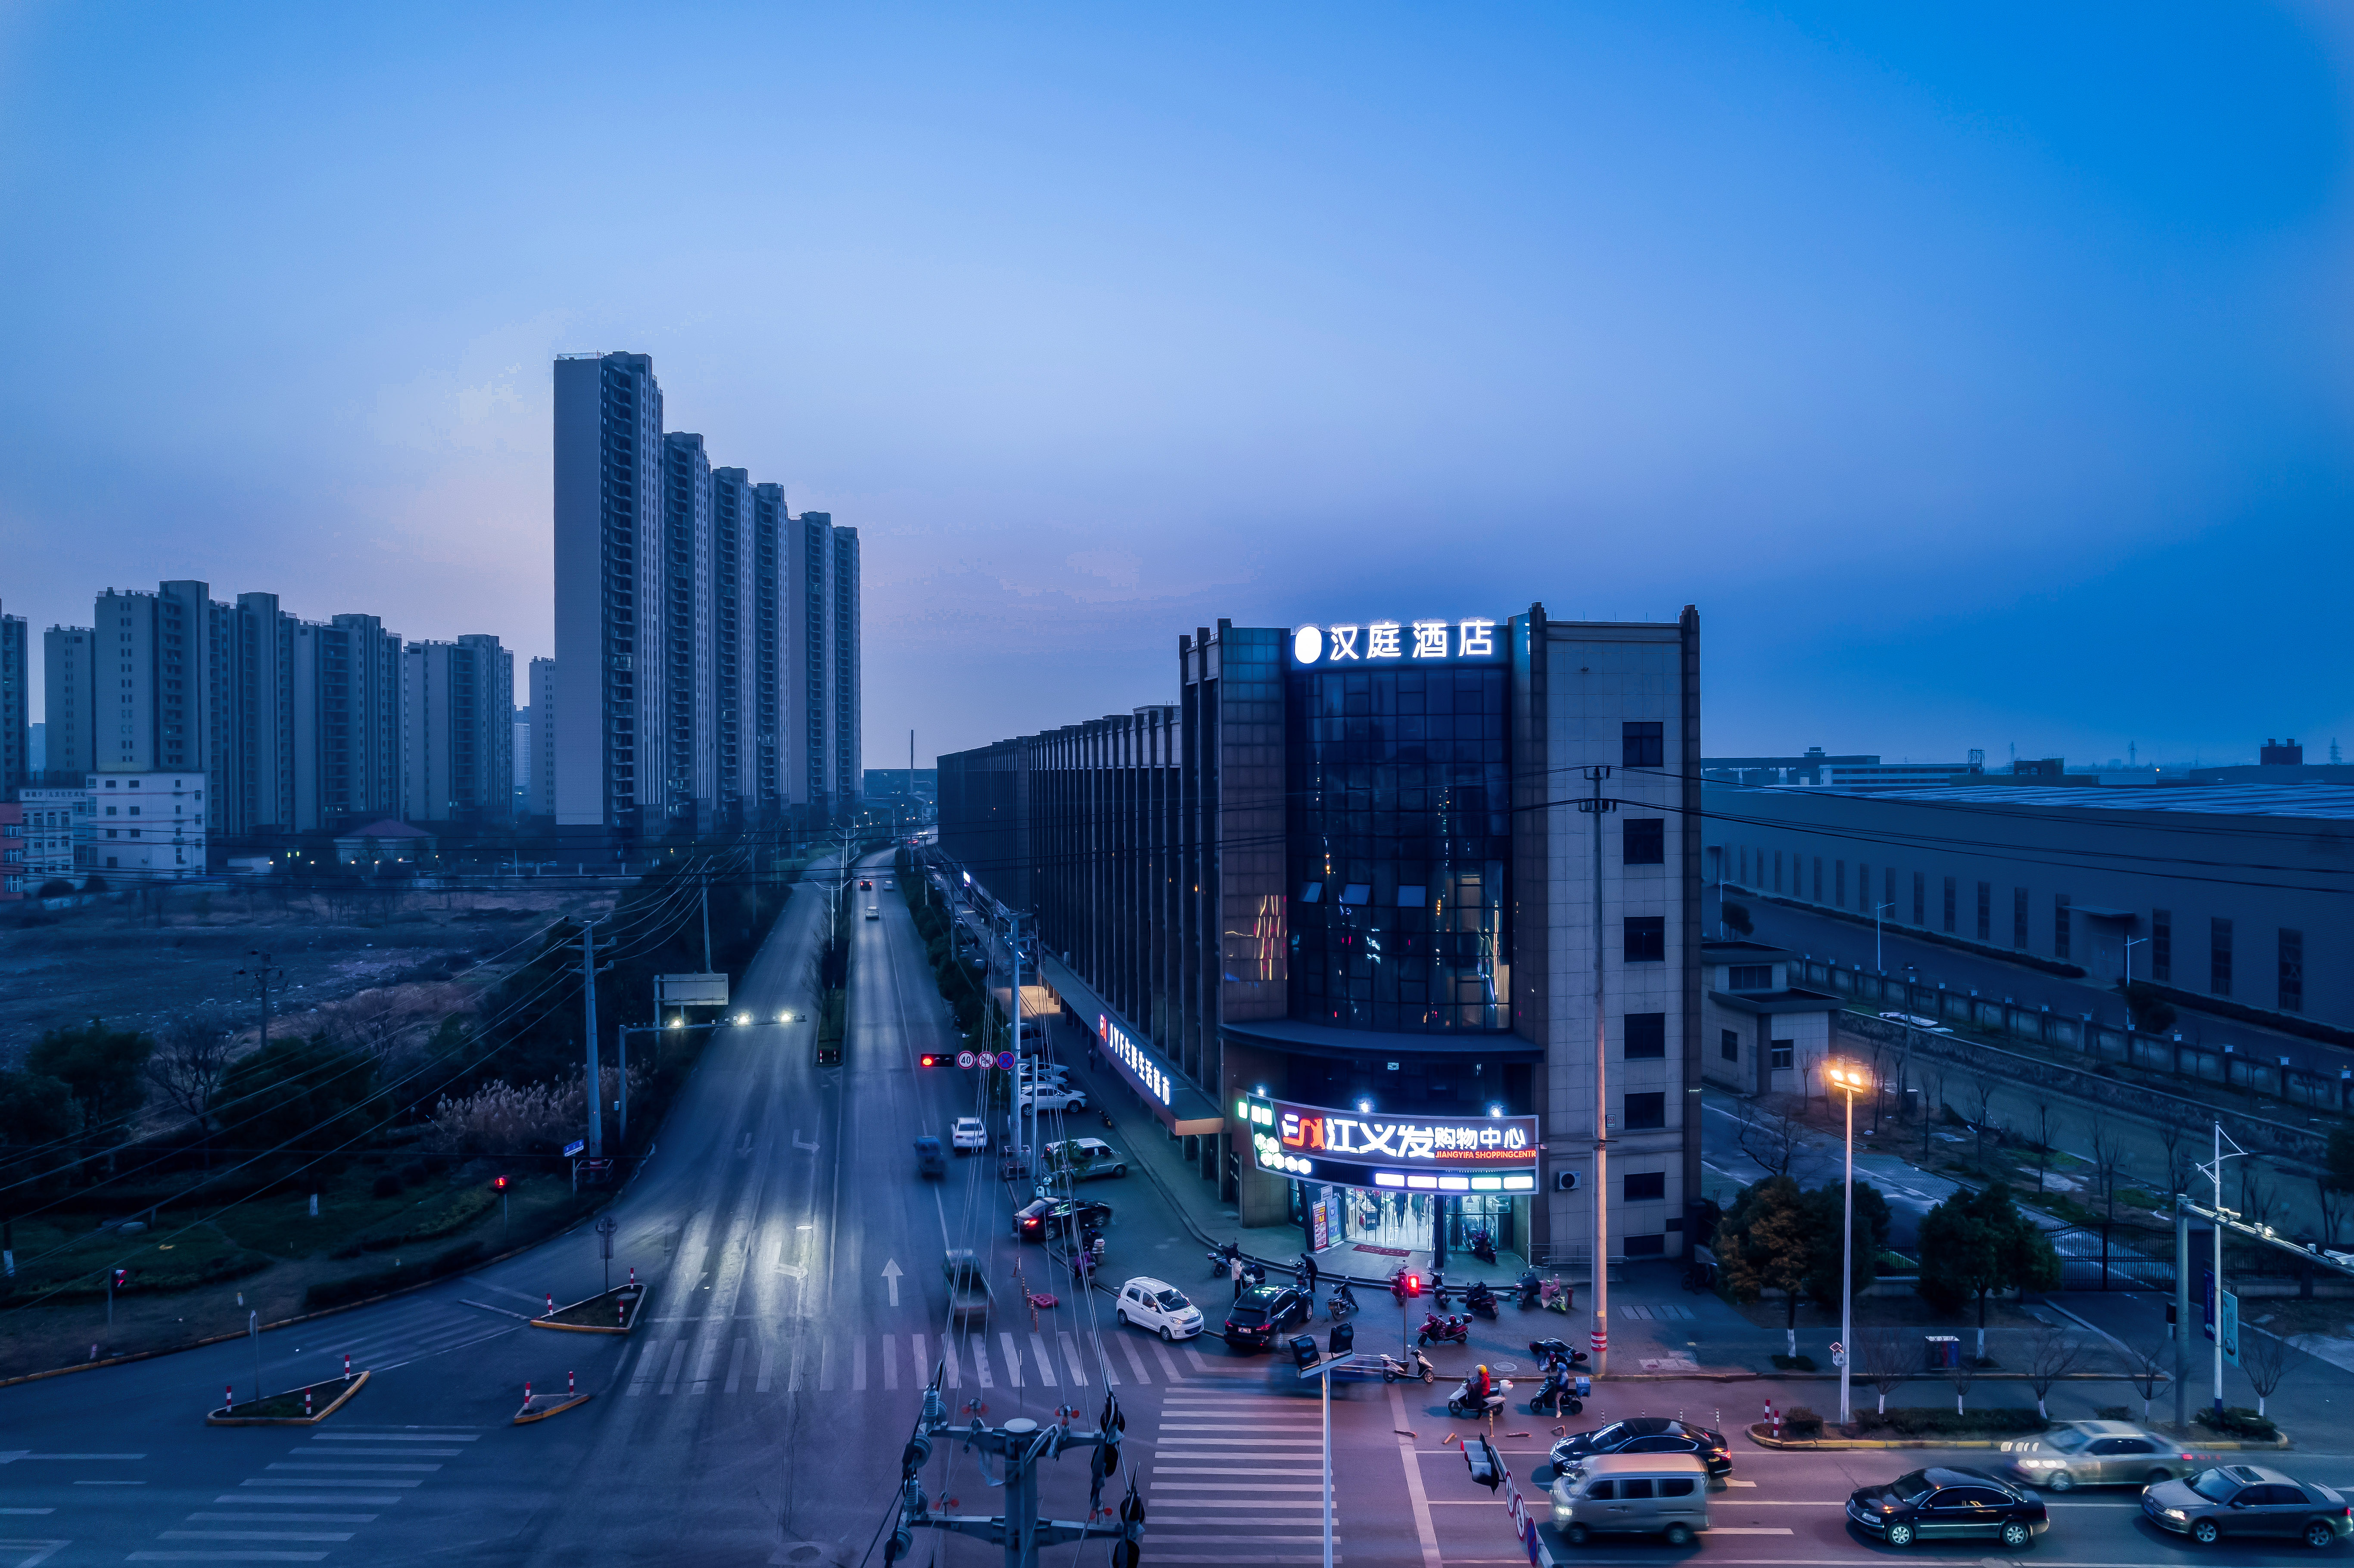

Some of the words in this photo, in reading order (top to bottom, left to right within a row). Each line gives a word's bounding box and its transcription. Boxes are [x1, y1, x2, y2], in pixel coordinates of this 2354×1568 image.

[1330, 619, 1495, 660] 汉庭酒店
[961, 1056, 971, 1064] 40
[1435, 1150, 1474, 1159] JIANGYIFA
